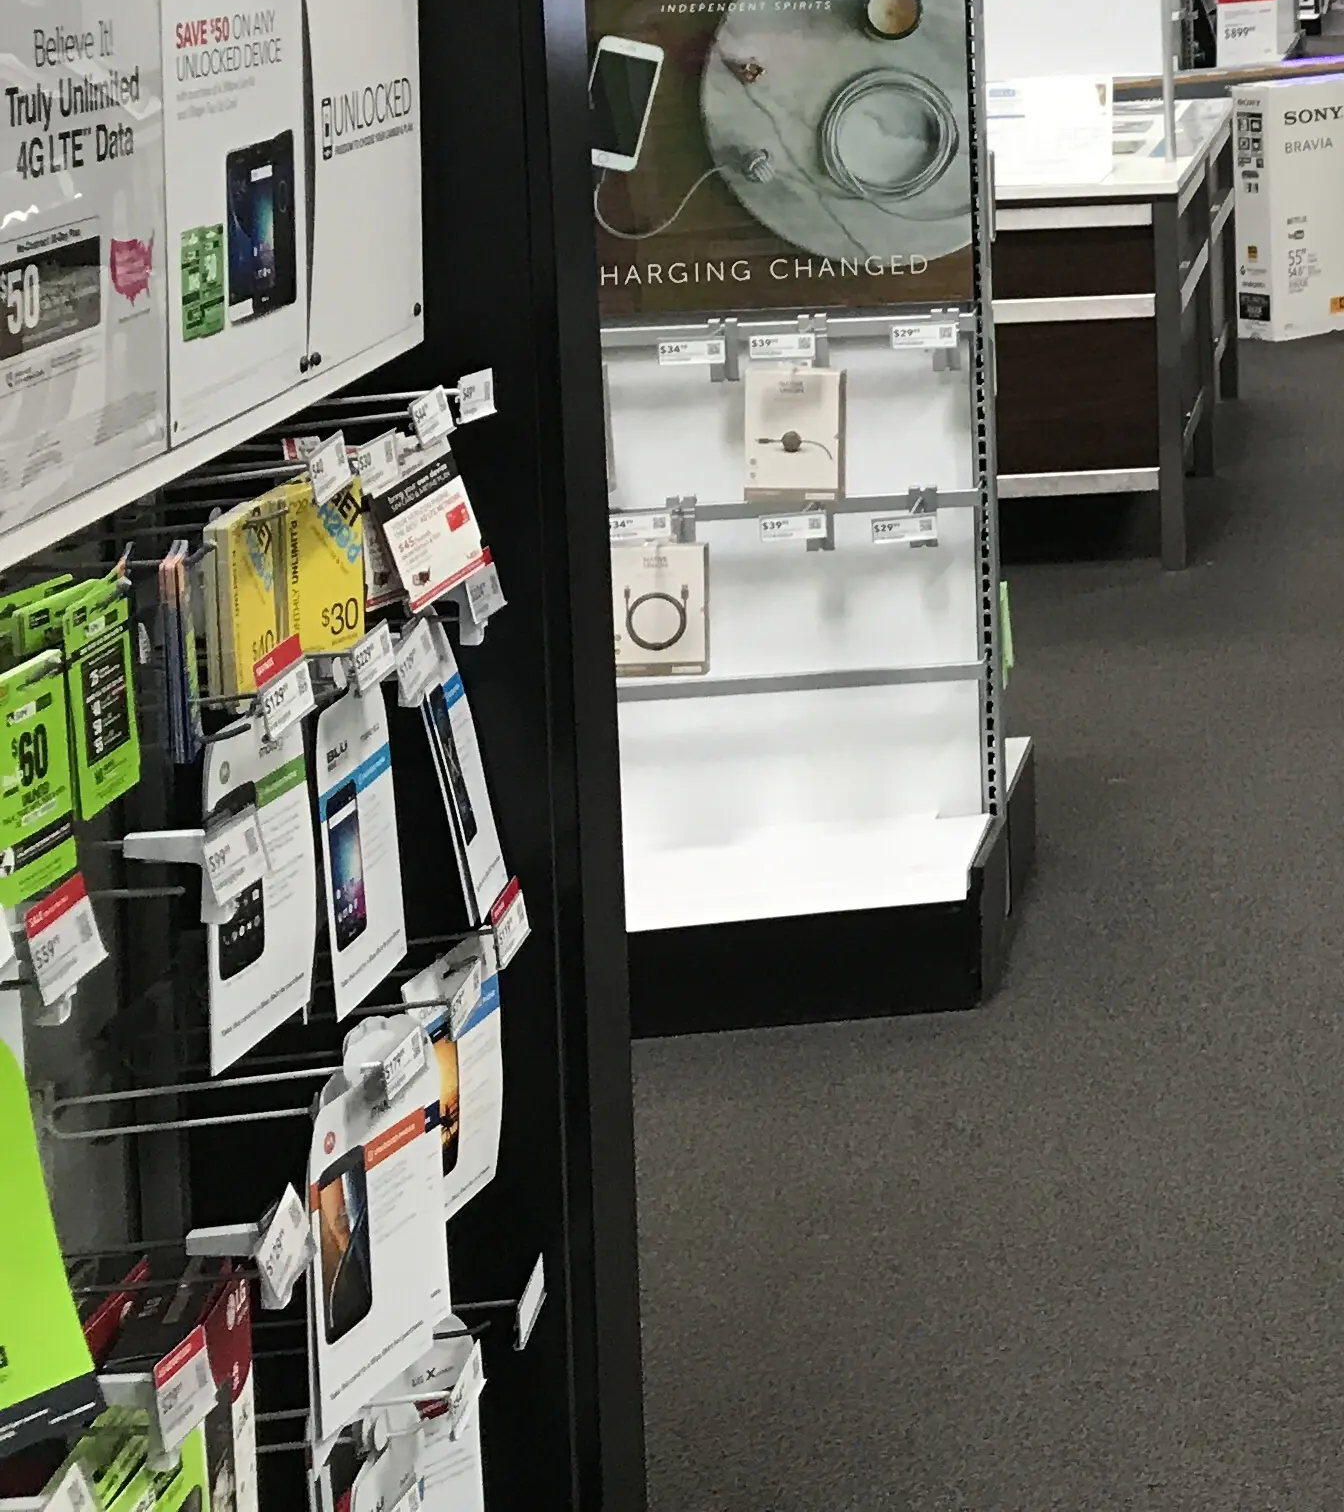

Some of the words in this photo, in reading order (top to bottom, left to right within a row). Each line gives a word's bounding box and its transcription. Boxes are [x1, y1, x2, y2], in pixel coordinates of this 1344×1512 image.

[660, 2, 766, 14] INDEPENDENT
[774, 0, 832, 12] SPIRITS
[33, 25, 95, 68] Believe
[176, 19, 208, 50] SAVE
[210, 15, 230, 42] $50
[232, 13, 250, 40] ON
[254, 9, 277, 35] ANY
[176, 44, 242, 81] UNLOCKED
[243, 37, 283, 69] DEVICE
[5, 83, 52, 131] Truly
[59, 65, 140, 117] Unlimited
[333, 76, 413, 137] UNLOCKED
[1284, 105, 1344, 126] SONY
[16, 137, 45, 180] 4G
[96, 122, 134, 162] Data
[1284, 136, 1334, 155] BRAVIA
[601, 259, 752, 286] HARGING
[770, 254, 929, 278] CHANGED
[321, 597, 359, 635] $30
[11, 723, 49, 787] $60
[326, 740, 348, 764] BLU
